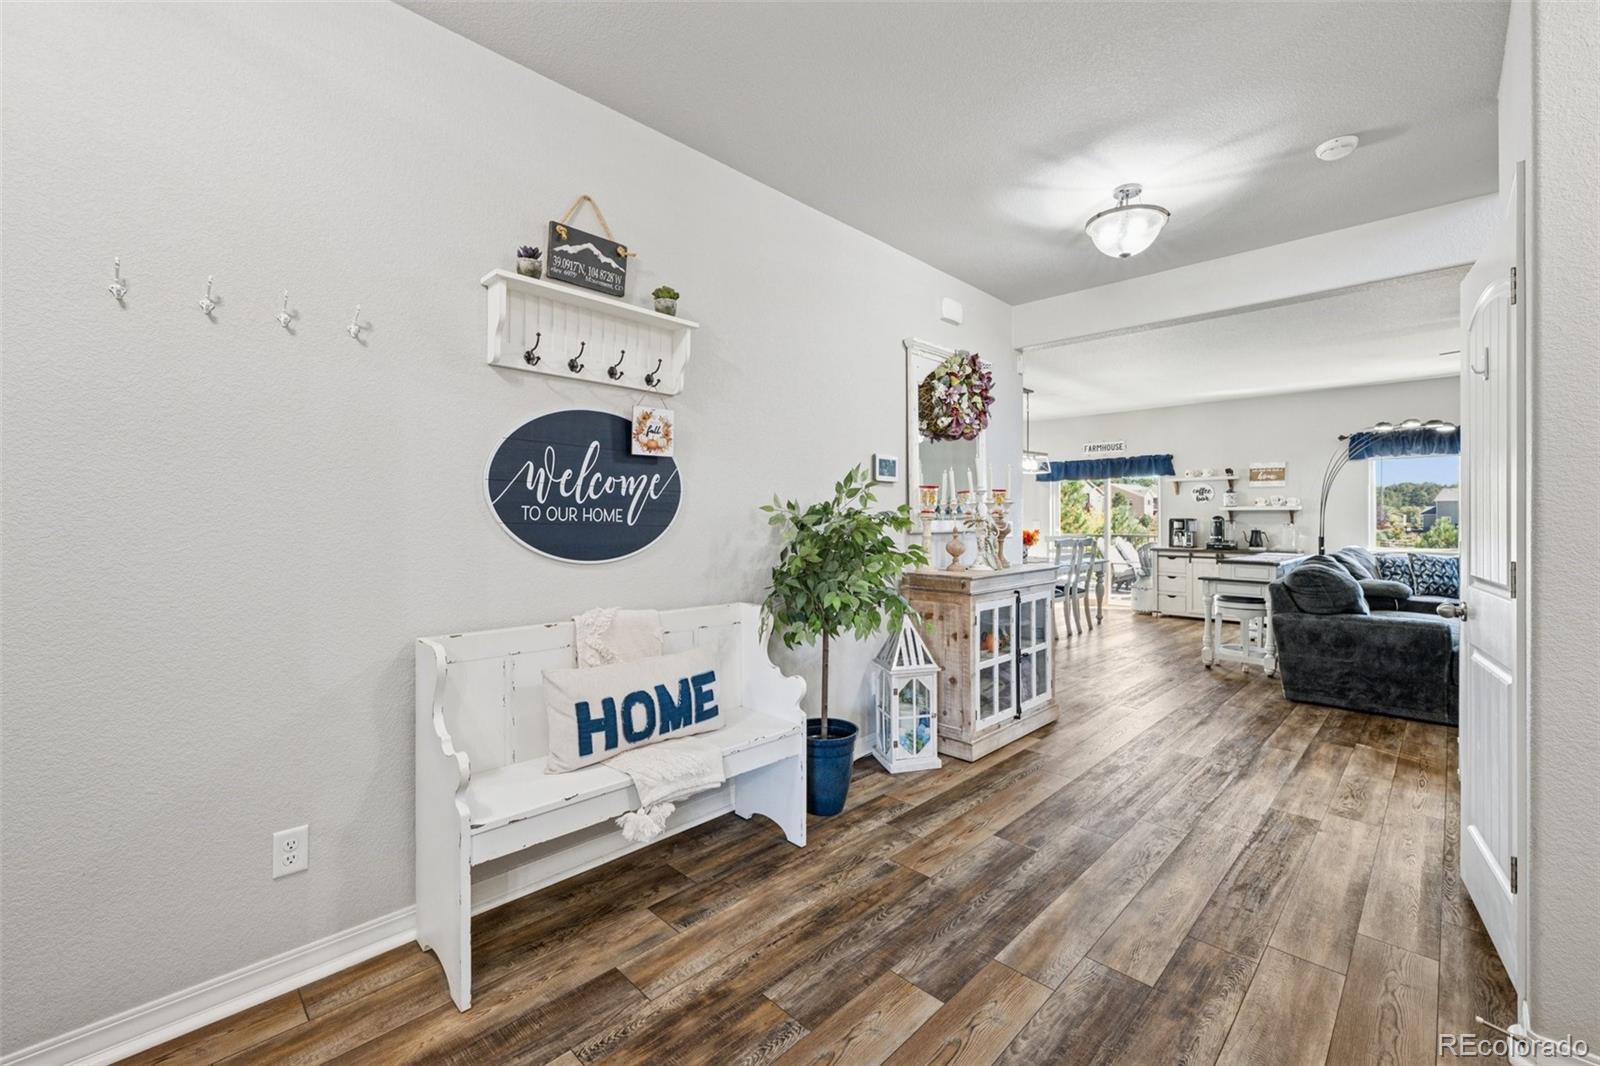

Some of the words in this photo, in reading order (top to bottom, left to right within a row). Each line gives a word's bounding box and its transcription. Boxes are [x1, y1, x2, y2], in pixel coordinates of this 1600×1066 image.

[646, 424, 661, 437] fall
[1083, 442, 1124, 453] FARMHOUSE
[492, 440, 678, 526] Welcome
[1192, 487, 1212, 496] coffee
[521, 505, 541, 521] TO
[546, 506, 578, 522] OUR
[582, 507, 624, 523] HOME
[575, 670, 719, 757] HOME
